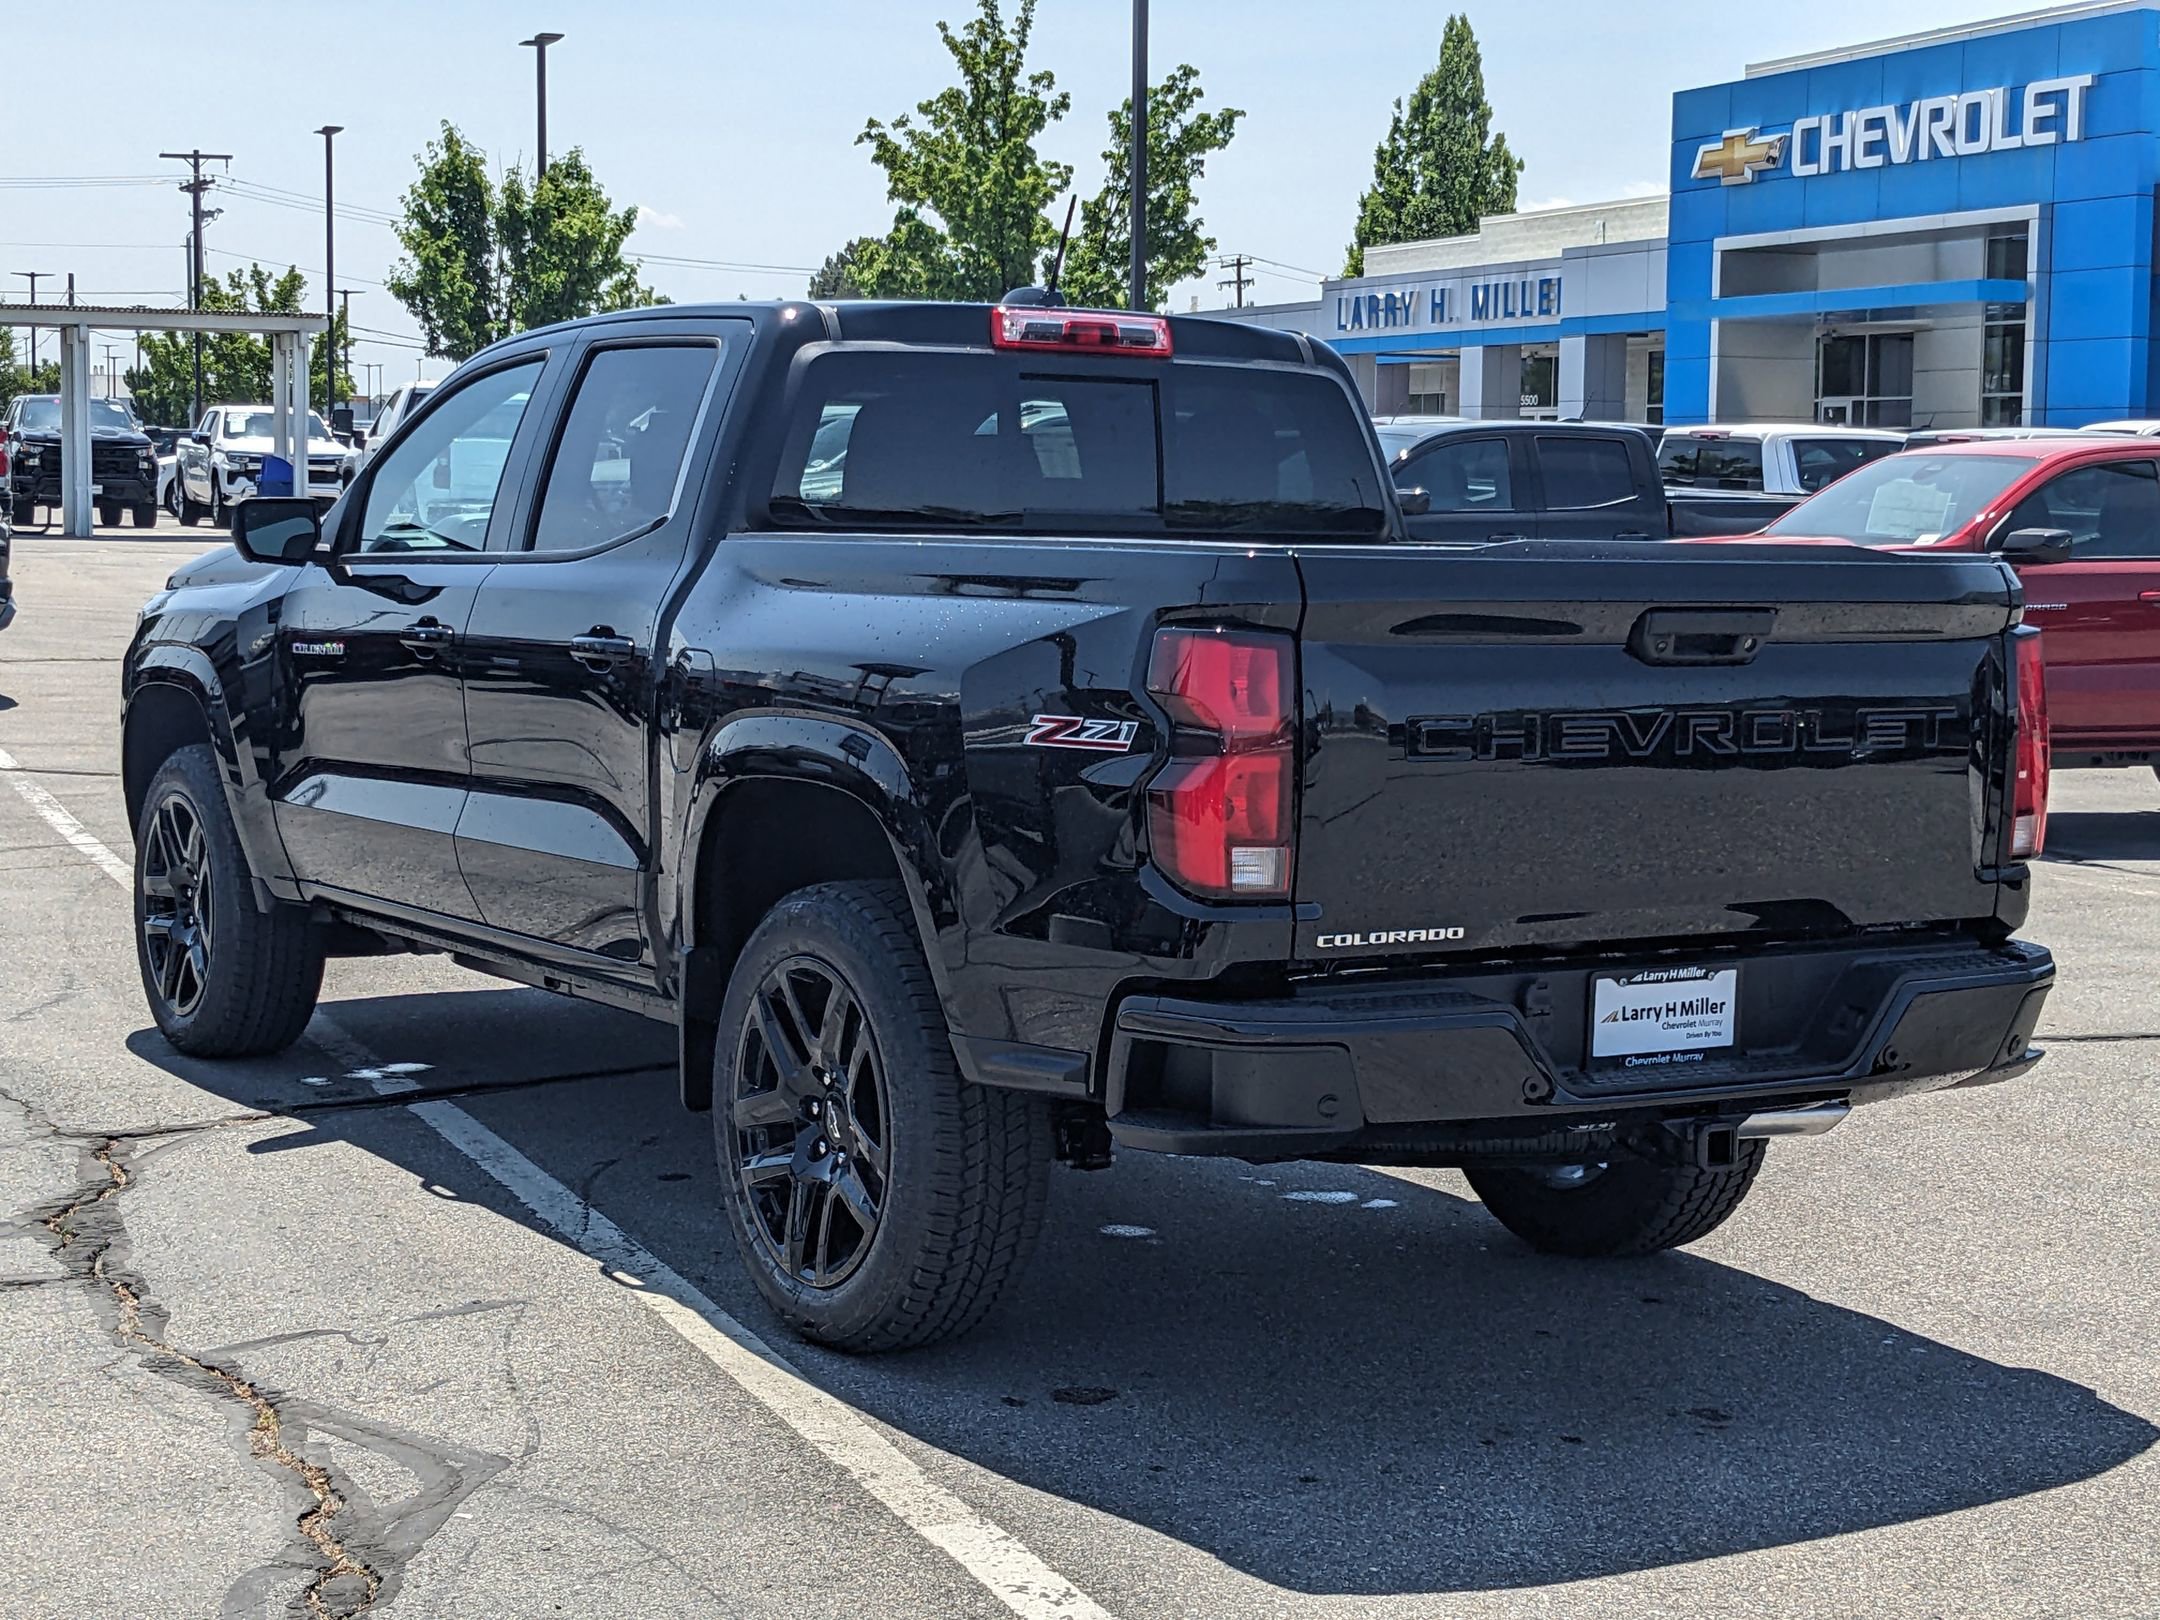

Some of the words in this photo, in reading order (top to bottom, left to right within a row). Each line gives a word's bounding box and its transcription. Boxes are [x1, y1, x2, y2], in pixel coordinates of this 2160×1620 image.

[1791, 73, 2097, 177] CHEVROLET
[1337, 289, 1418, 331] LARRY
[1520, 395, 1538, 405] 5500
[1023, 714, 1139, 752] Z71
[1405, 706, 1959, 762] CHEVROLET
[1316, 926, 1465, 948] COLORADO
[1643, 969, 1669, 983] Larry
[1669, 969, 1677, 980] H
[1678, 966, 1706, 978] Miller
[1621, 1004, 1663, 1023] Larry
[1665, 1001, 1677, 1017] H
[1680, 997, 1726, 1016] Miller
[1661, 1020, 1697, 1030] Chevrolet
[1697, 1017, 1723, 1028] Murray
[1685, 1031, 1703, 1040] Driven
[1704, 1030, 1711, 1039] By
[1711, 1030, 1722, 1038] You
[1624, 1054, 1670, 1068] Chevrolet
[1671, 1052, 1704, 1063] Murray
